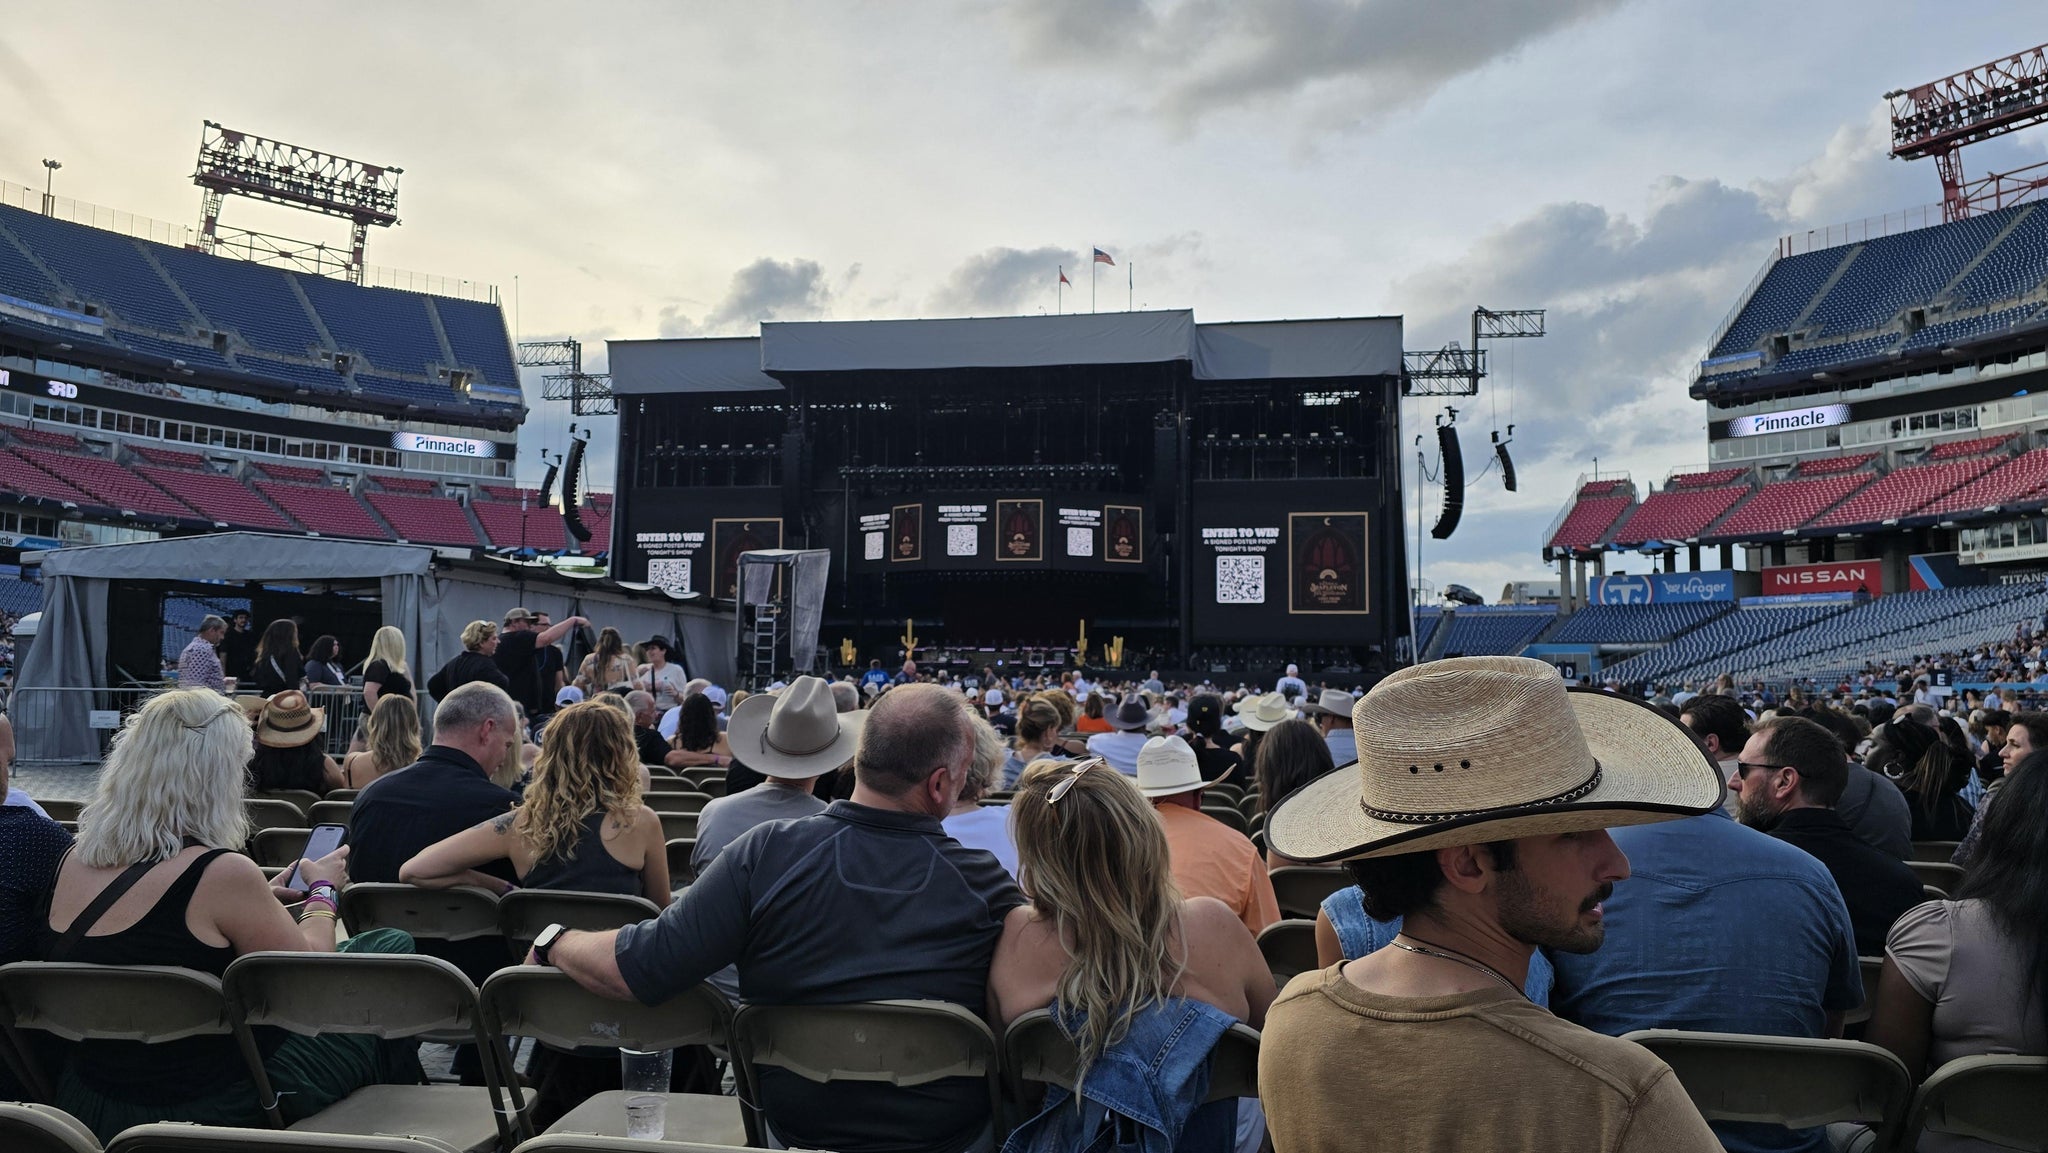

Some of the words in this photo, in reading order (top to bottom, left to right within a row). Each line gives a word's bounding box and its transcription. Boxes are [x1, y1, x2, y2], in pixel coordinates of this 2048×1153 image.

[48, 380, 78, 398] 3RD
[1754, 410, 1824, 432] Pinnacle
[416, 436, 475, 454] Pinnacle
[636, 533, 667, 542] ENTER
[668, 533, 682, 541] TO
[683, 533, 705, 541] WIN
[1202, 528, 1238, 538] ENTER
[1238, 528, 1254, 537] TO
[1255, 528, 1280, 537] WIN
[0, 536, 13, 545] cle
[1776, 568, 1865, 585] NISSAN
[2000, 572, 2048, 585] TITANS
[1682, 577, 1726, 600] Kroger
[1774, 594, 1801, 602] TITANS
[1566, 666, 1573, 678] D
[1937, 674, 1946, 685] E
